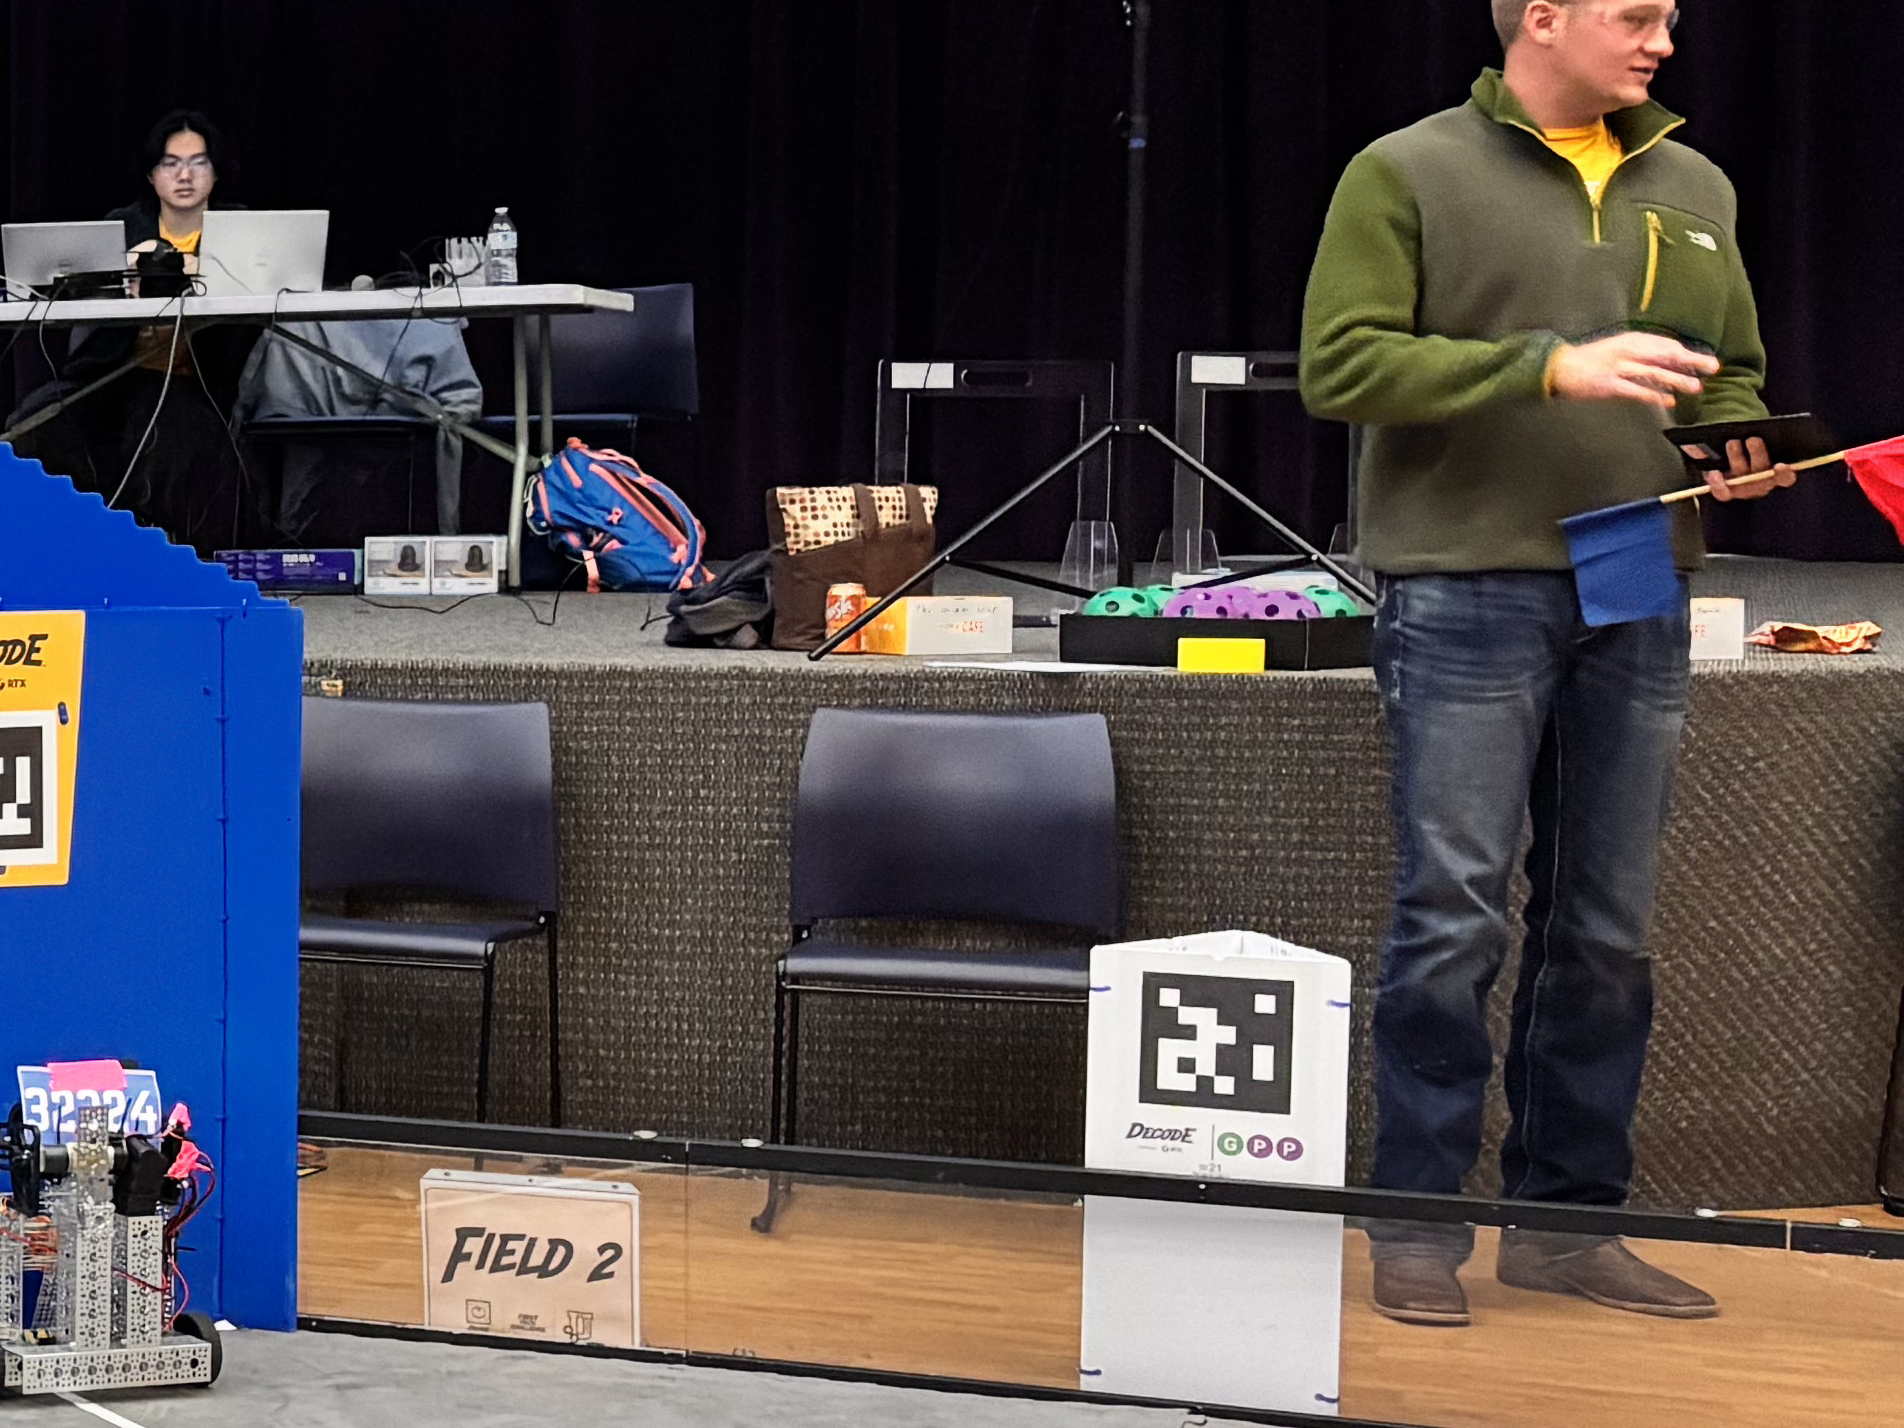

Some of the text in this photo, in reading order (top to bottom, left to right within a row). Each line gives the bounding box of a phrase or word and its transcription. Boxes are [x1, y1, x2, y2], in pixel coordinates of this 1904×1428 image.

[8, 679, 26, 688] RTX
[1126, 1123, 1197, 1144] DECODE
[441, 1227, 623, 1284] FIELD 2
